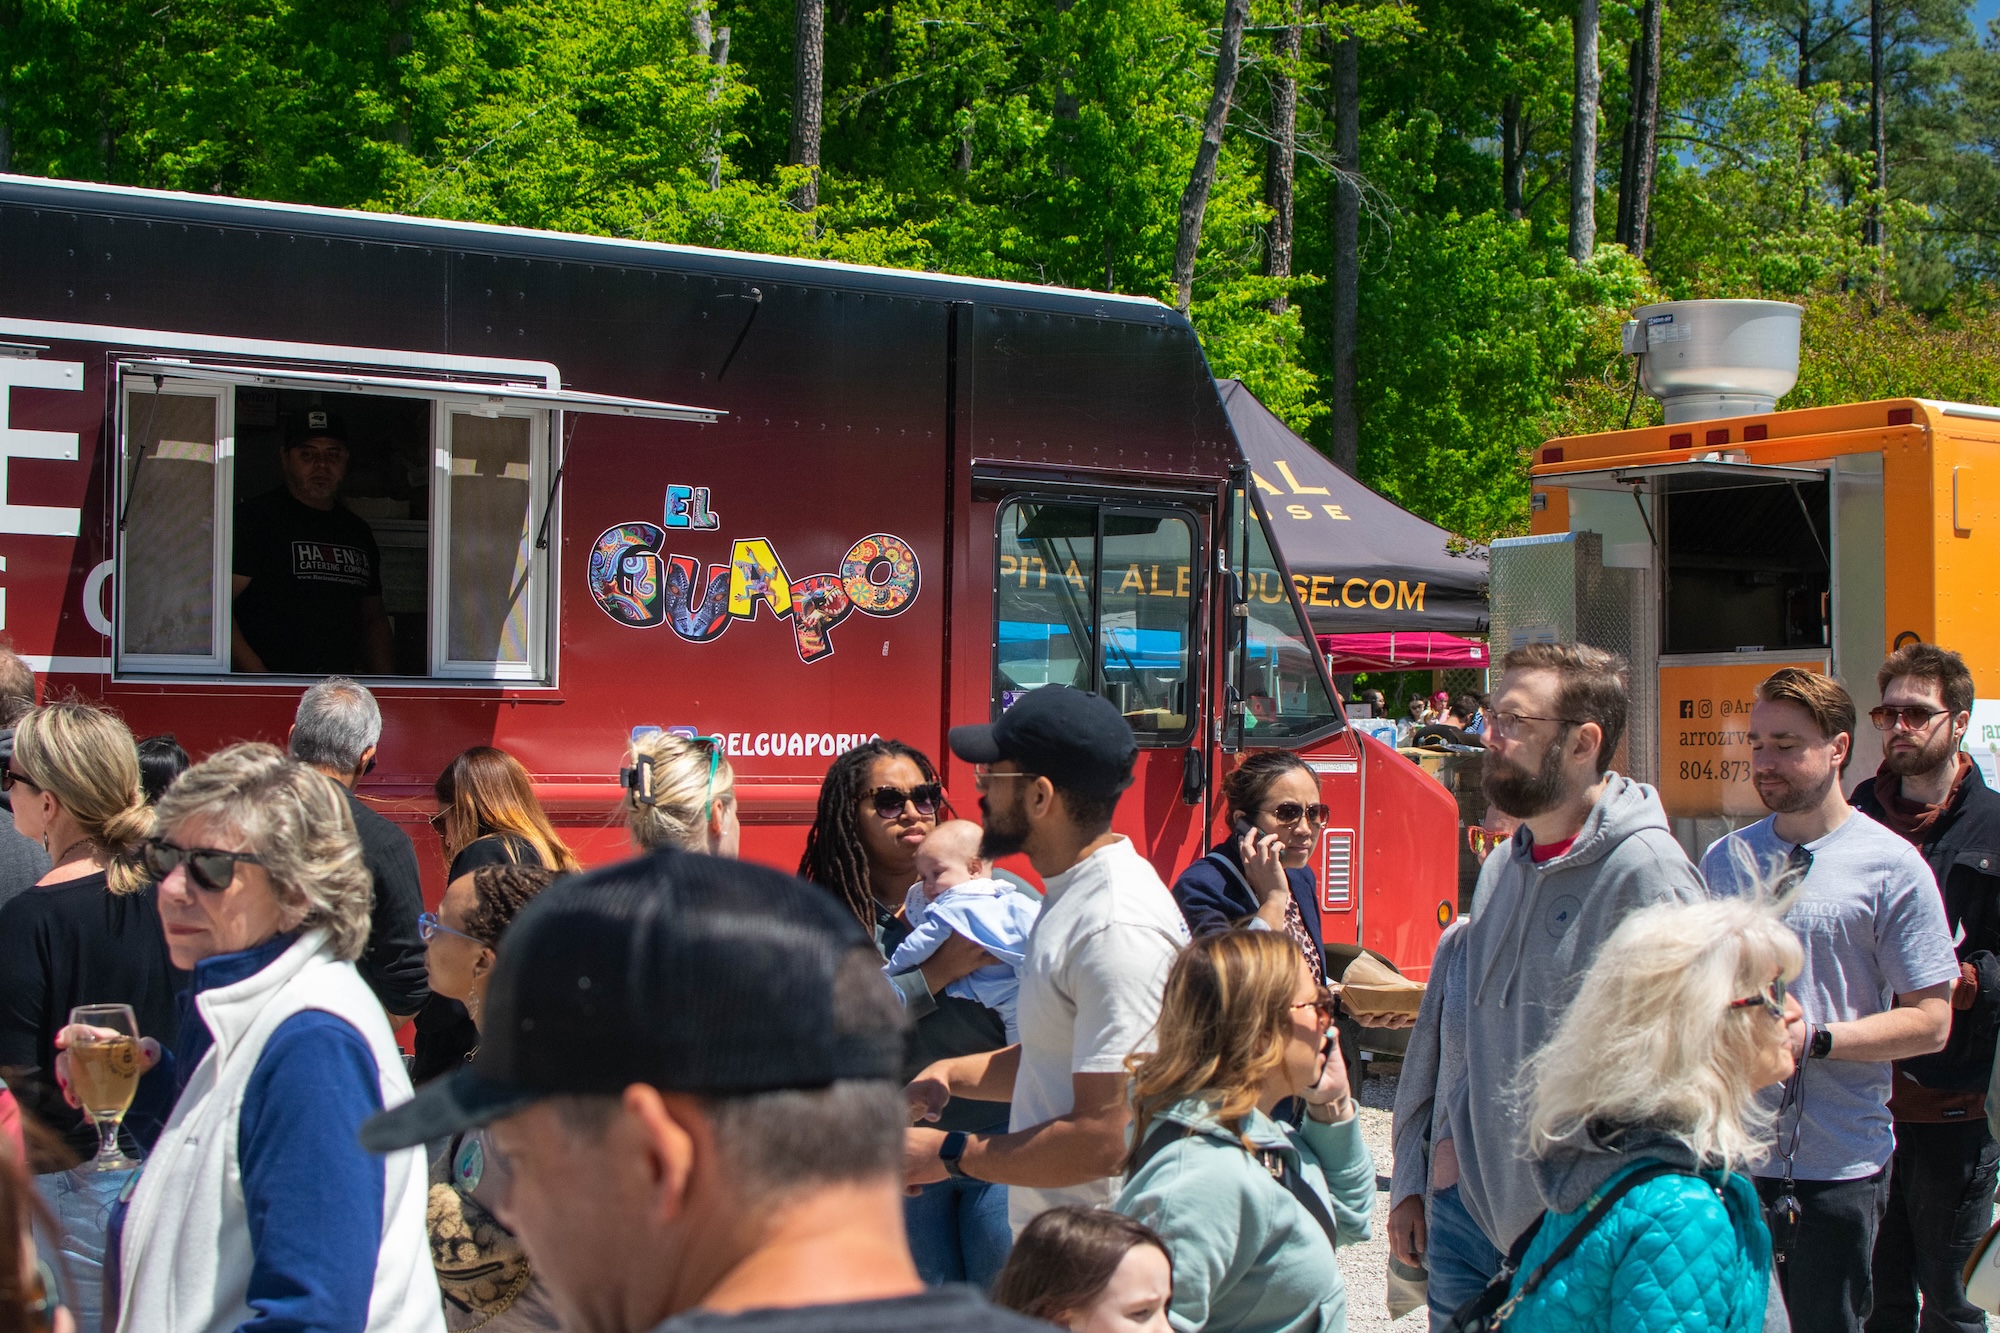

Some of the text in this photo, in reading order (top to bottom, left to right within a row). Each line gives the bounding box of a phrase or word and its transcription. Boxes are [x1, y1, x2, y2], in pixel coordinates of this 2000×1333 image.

[664, 484, 720, 531] EL
[300, 560, 371, 578] CATERING COMPAN
[587, 521, 922, 664] GUAPO
[1680, 760, 1751, 783] 804.873
[1799, 902, 1841, 918] TACO
